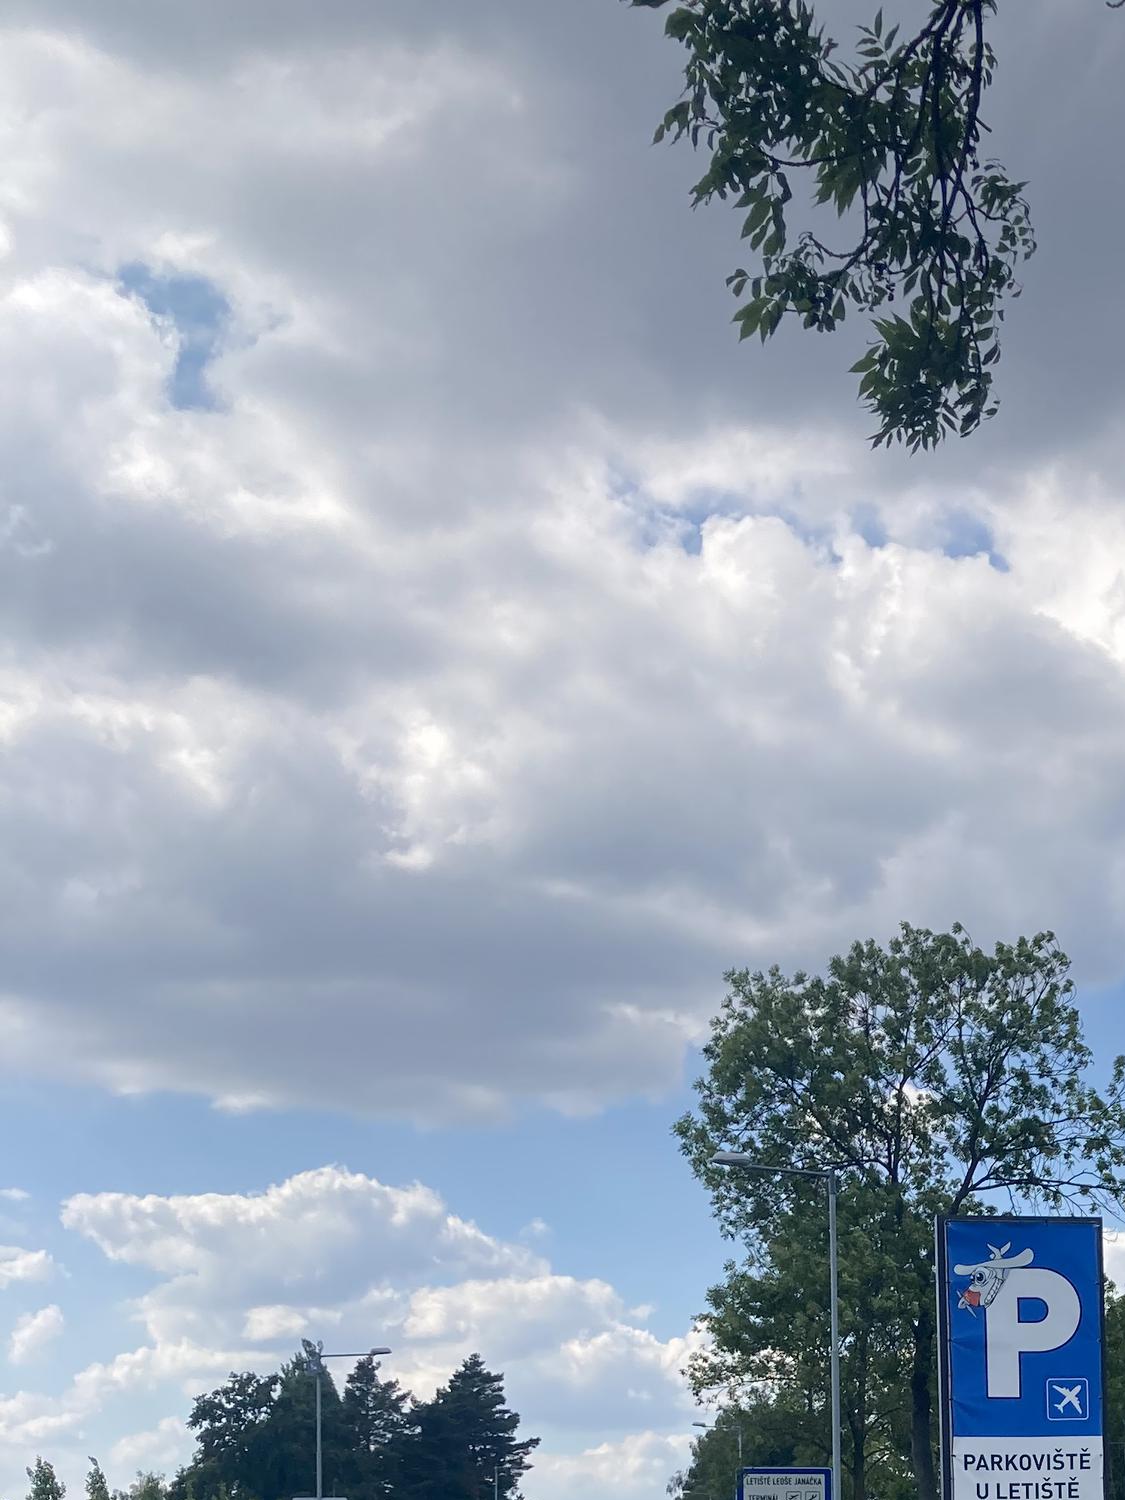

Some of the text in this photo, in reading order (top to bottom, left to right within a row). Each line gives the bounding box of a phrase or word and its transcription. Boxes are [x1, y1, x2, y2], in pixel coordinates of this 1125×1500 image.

[986, 1267, 1081, 1399] P
[963, 1447, 1092, 1471] PARKOVIŠTĚ
[746, 1475, 822, 1486] LETIŠTĚ LEOŠE JANÁČKA
[976, 1476, 1080, 1500] U LETIŠTĚ
